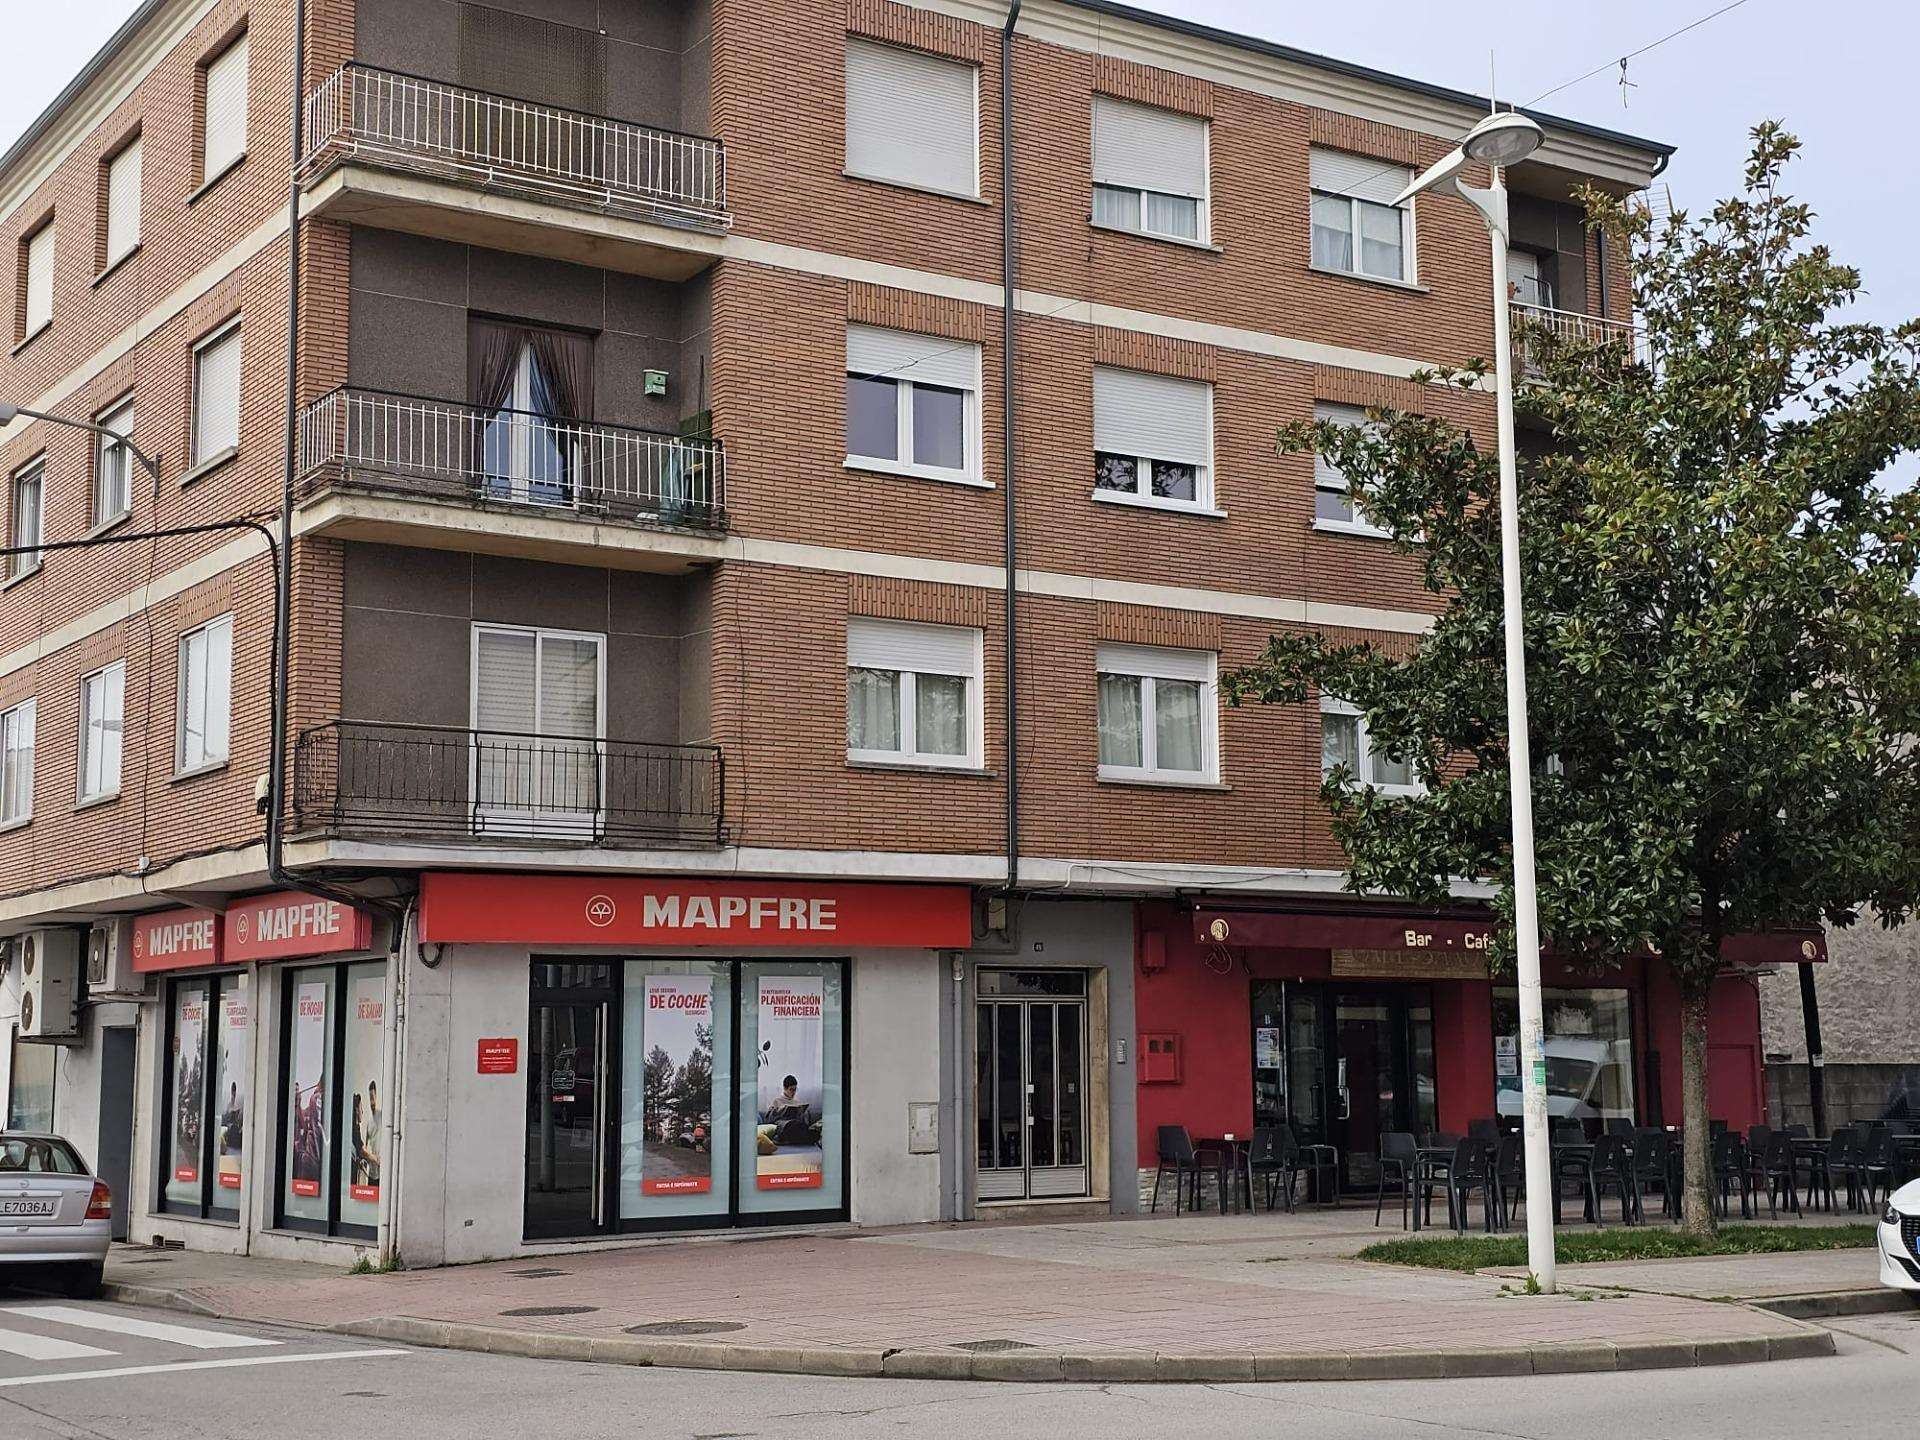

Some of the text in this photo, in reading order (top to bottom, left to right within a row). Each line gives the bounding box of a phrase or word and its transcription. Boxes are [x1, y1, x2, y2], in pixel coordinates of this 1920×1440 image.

[643, 895, 836, 930] MAPFRE
[257, 901, 340, 942] MAPFRE
[150, 919, 214, 956] MAPFRE
[1405, 930, 1432, 947] Bar
[650, 994, 708, 1009] DE COCHE
[761, 992, 821, 1006] PLANIFICACIÓN
[774, 1006, 820, 1017] FINANCIERA
